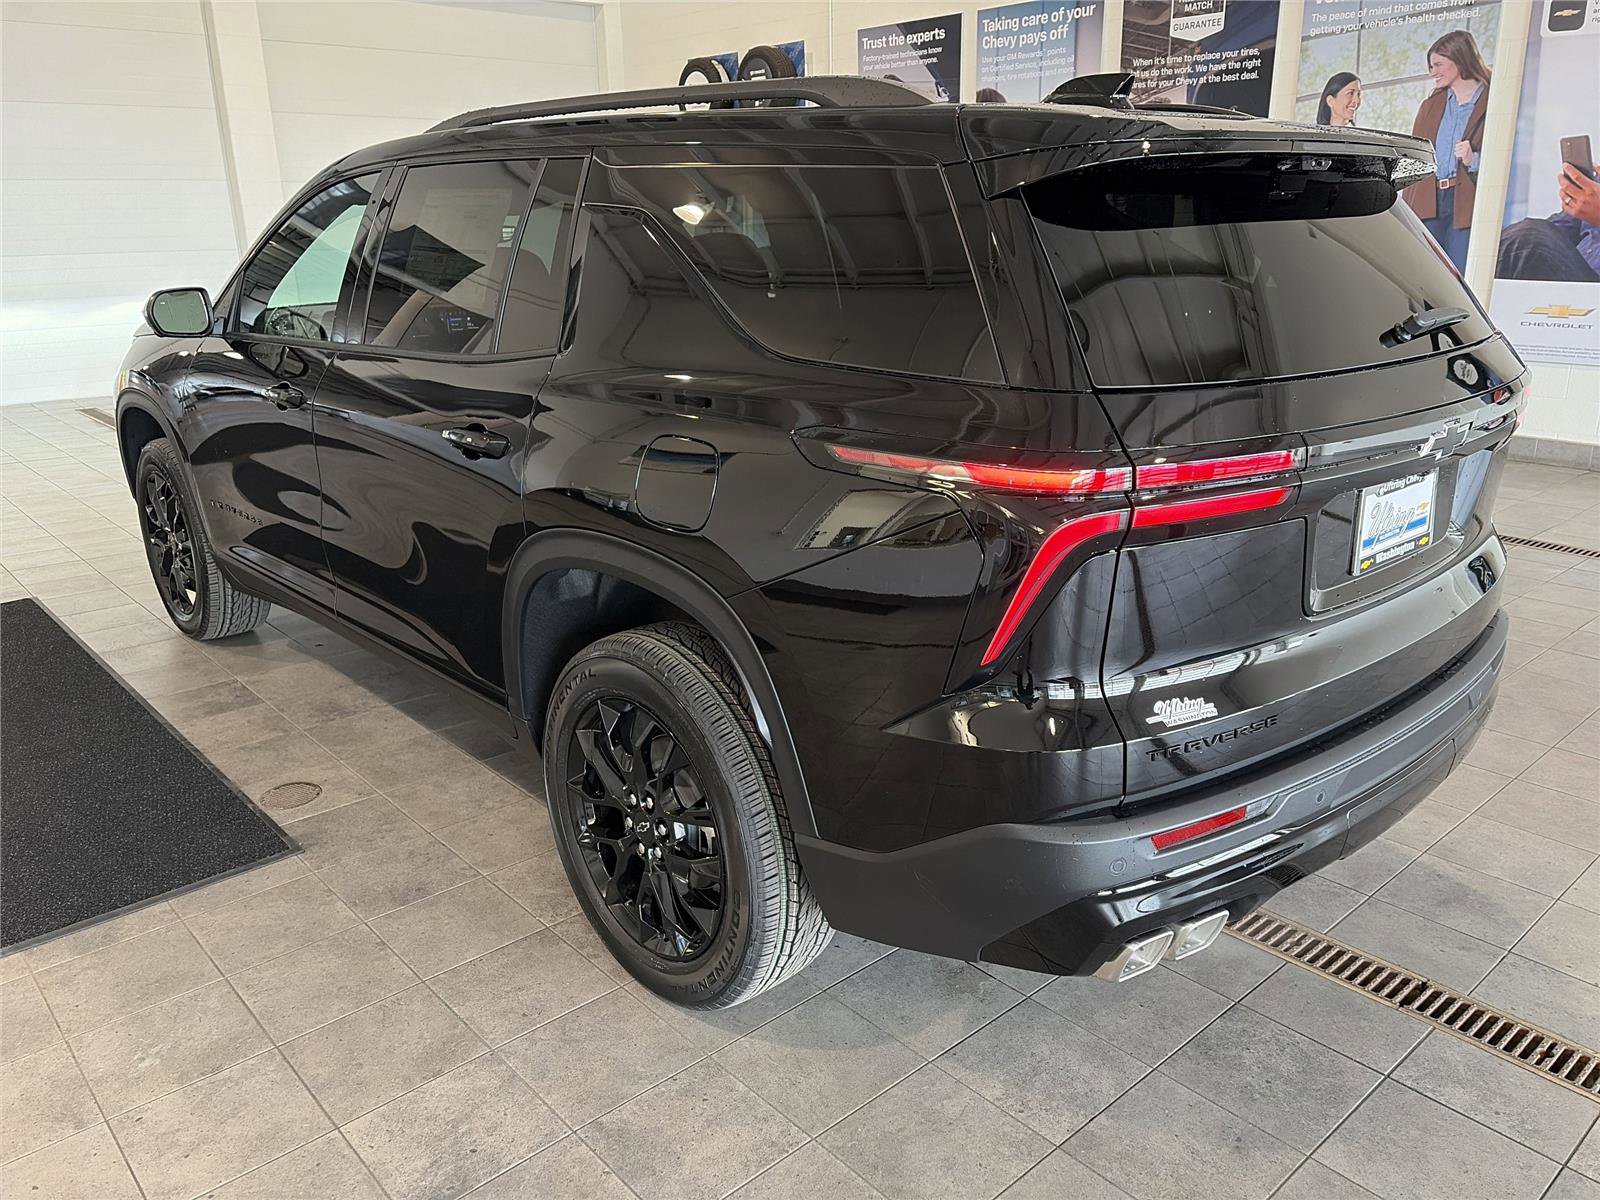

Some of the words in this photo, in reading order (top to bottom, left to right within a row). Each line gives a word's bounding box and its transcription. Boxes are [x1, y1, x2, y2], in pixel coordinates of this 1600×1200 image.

[1184, 1, 1213, 12] MATCH
[1312, 13, 1327, 22] The
[1329, 11, 1356, 22] peace
[1358, 8, 1367, 17] of
[1369, 5, 1392, 16] mind
[1394, 3, 1413, 13] that
[1415, 1, 1448, 10] comes
[982, 16, 1019, 33] Taking
[1022, 13, 1048, 27] care
[1051, 7, 1064, 22] of
[1067, 4, 1096, 23] your
[1173, 17, 1222, 31] GUARANTEE
[1310, 25, 1341, 37] getting
[1342, 23, 1363, 33] your
[1365, 17, 1404, 29] vehicle's
[1405, 12, 1436, 24] health
[1437, 7, 1481, 21] checked.
[862, 36, 887, 49] Trust
[888, 33, 905, 46] the
[906, 28, 946, 44] experts
[982, 33, 1016, 49] Chevy
[1019, 31, 1047, 46] pays
[1049, 24, 1068, 40] off
[1132, 57, 1153, 67] When
[1154, 56, 1165, 65] it's
[1166, 56, 1183, 64] time
[1193, 51, 1221, 62] replace
[1221, 50, 1239, 60] your
[1240, 48, 1260, 56] tires,
[1150, 68, 1160, 77] do
[1161, 67, 1173, 75] the
[1174, 64, 1194, 74] work.
[1195, 64, 1208, 72] We
[1208, 63, 1227, 71] have
[1228, 60, 1241, 69] the
[1242, 58, 1262, 69] right
[1158, 79, 1175, 89] your
[1175, 77, 1198, 86] Chevy
[1198, 76, 1207, 84] at
[1208, 74, 1221, 83] the
[1222, 73, 1240, 82] best
[1240, 70, 1260, 80] deal.
[1520, 321, 1594, 330] CHEVROLET
[1375, 541, 1415, 563] Washington
[1165, 710, 1218, 726] WASHINGTON
[1146, 714, 1278, 761] TRAVERSE
